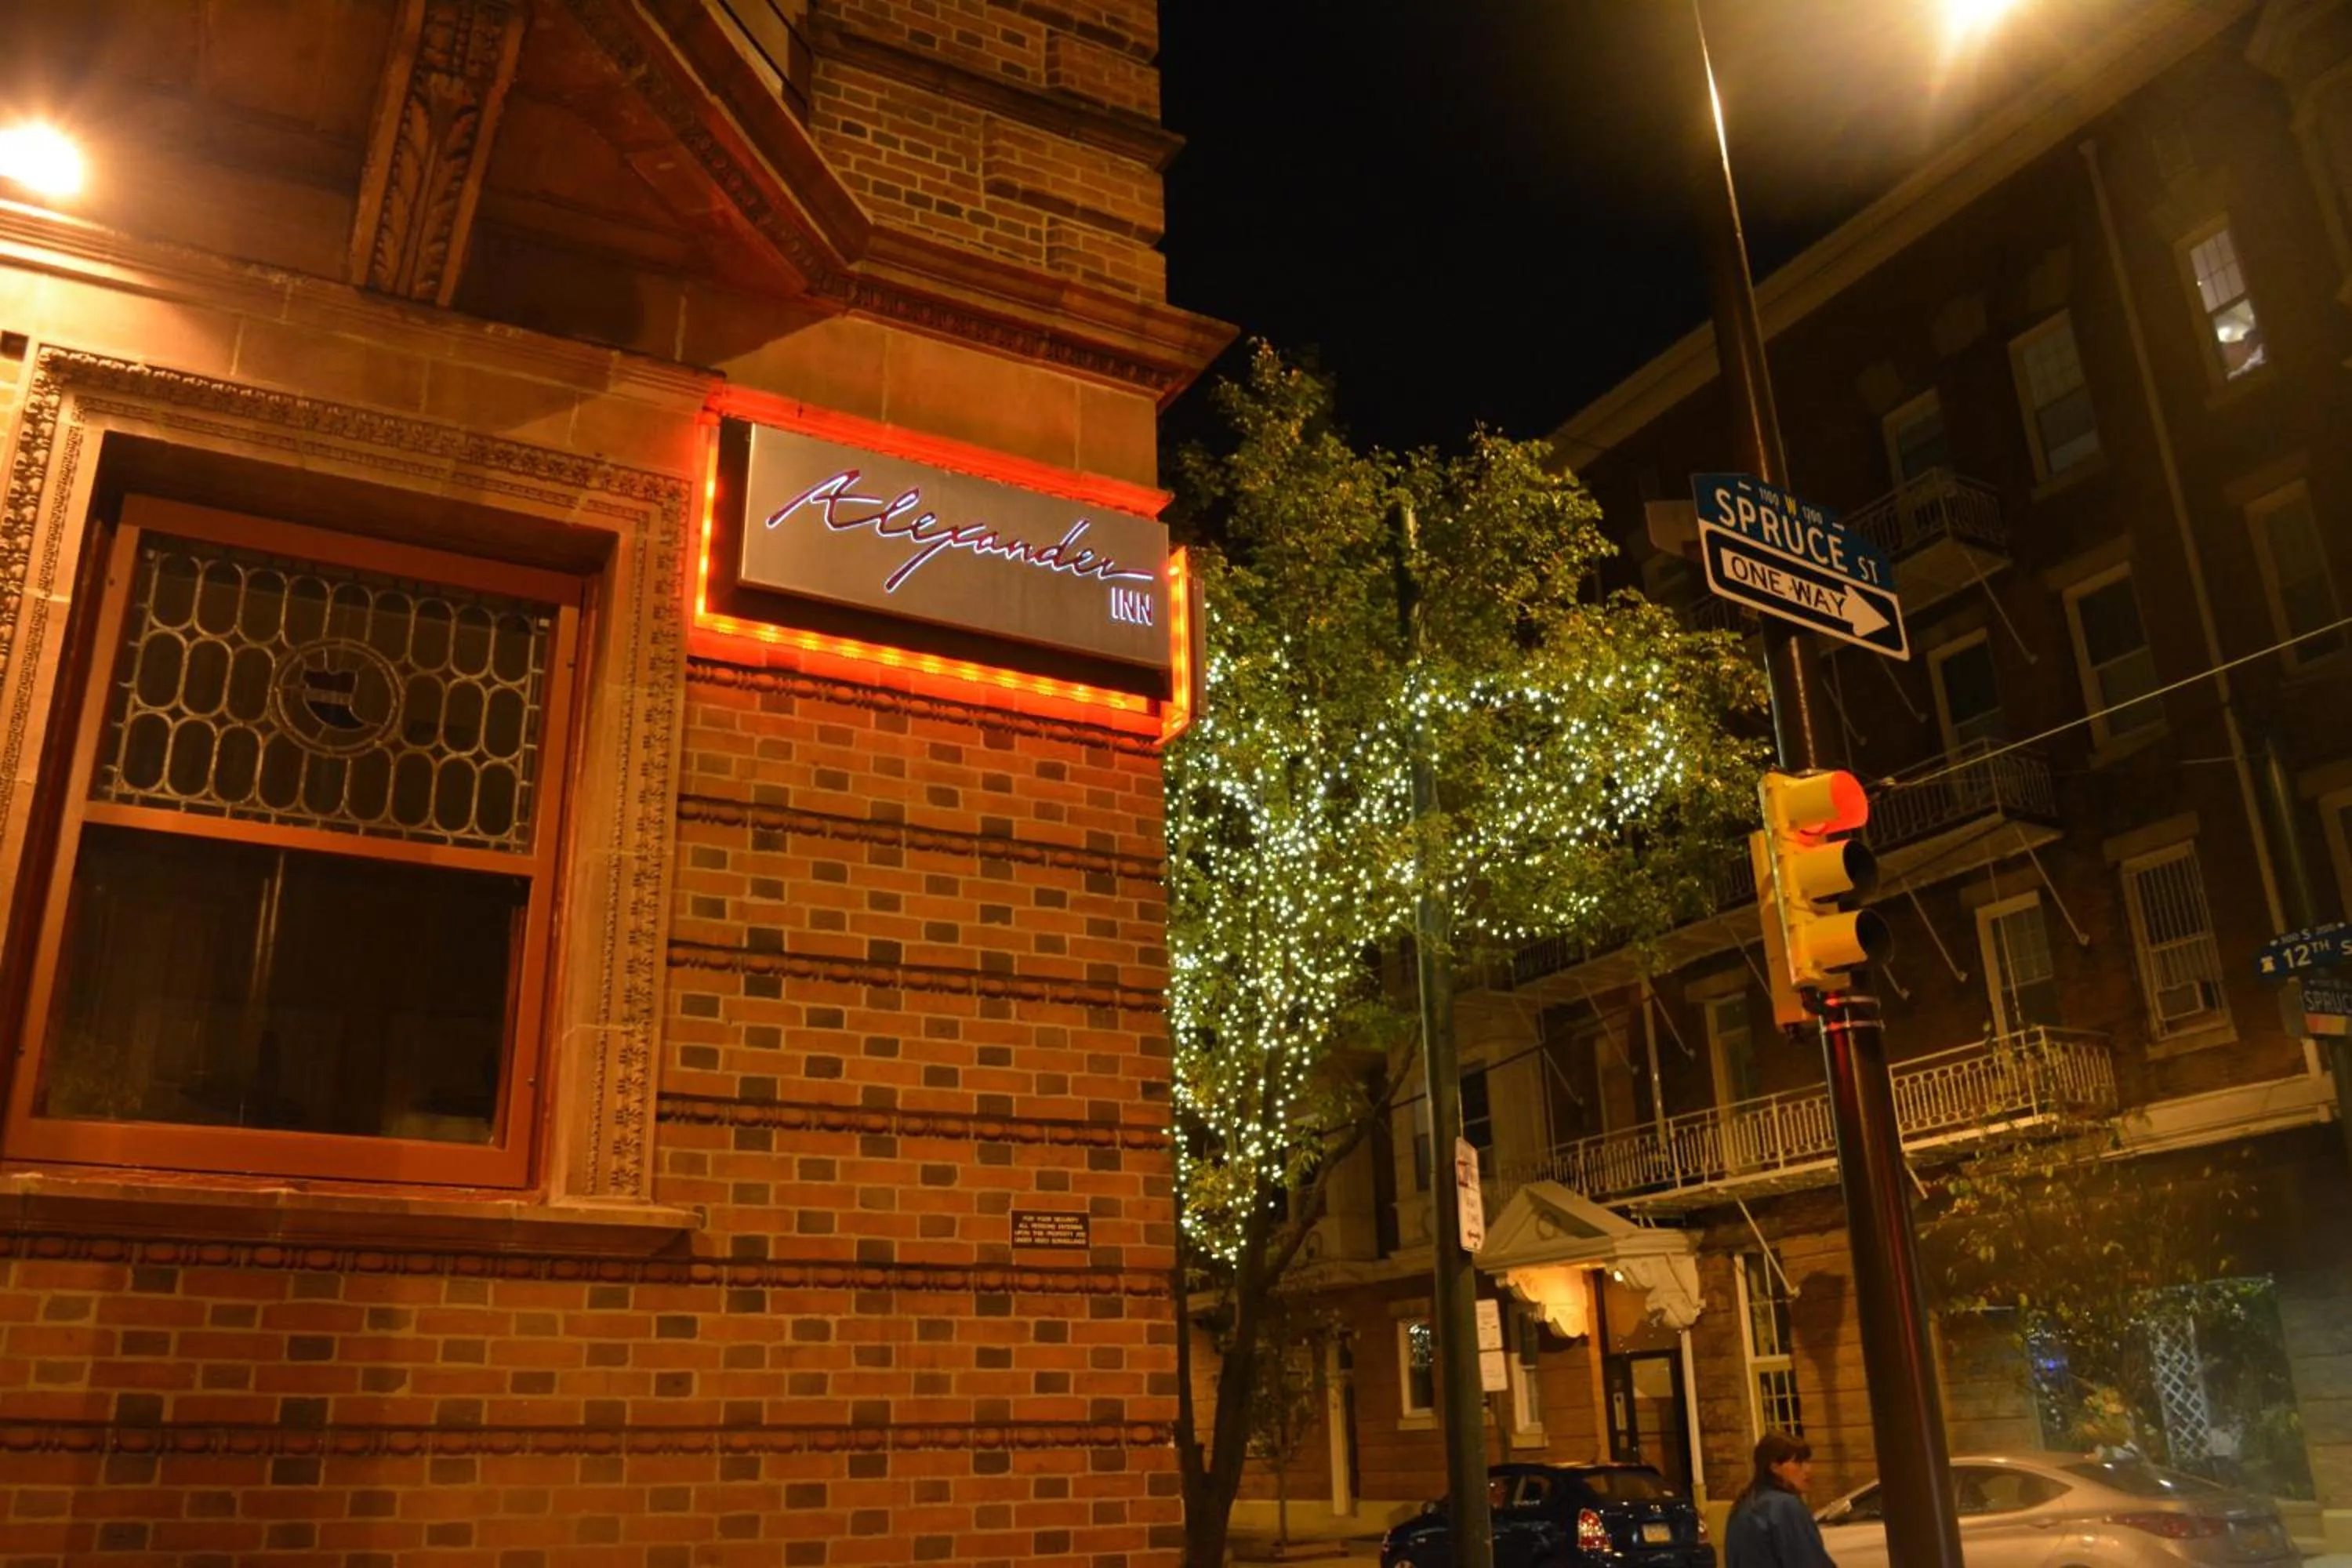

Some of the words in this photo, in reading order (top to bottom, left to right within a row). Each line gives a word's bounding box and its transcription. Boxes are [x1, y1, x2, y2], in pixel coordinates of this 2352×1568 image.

[765, 469, 1154, 593] Alexander
[1715, 487, 1848, 573] SPRUCE
[1857, 555, 1878, 584] ST
[1110, 586, 1153, 626] INN
[1730, 556, 1785, 595] ONE
[1791, 578, 1847, 616] WAY
